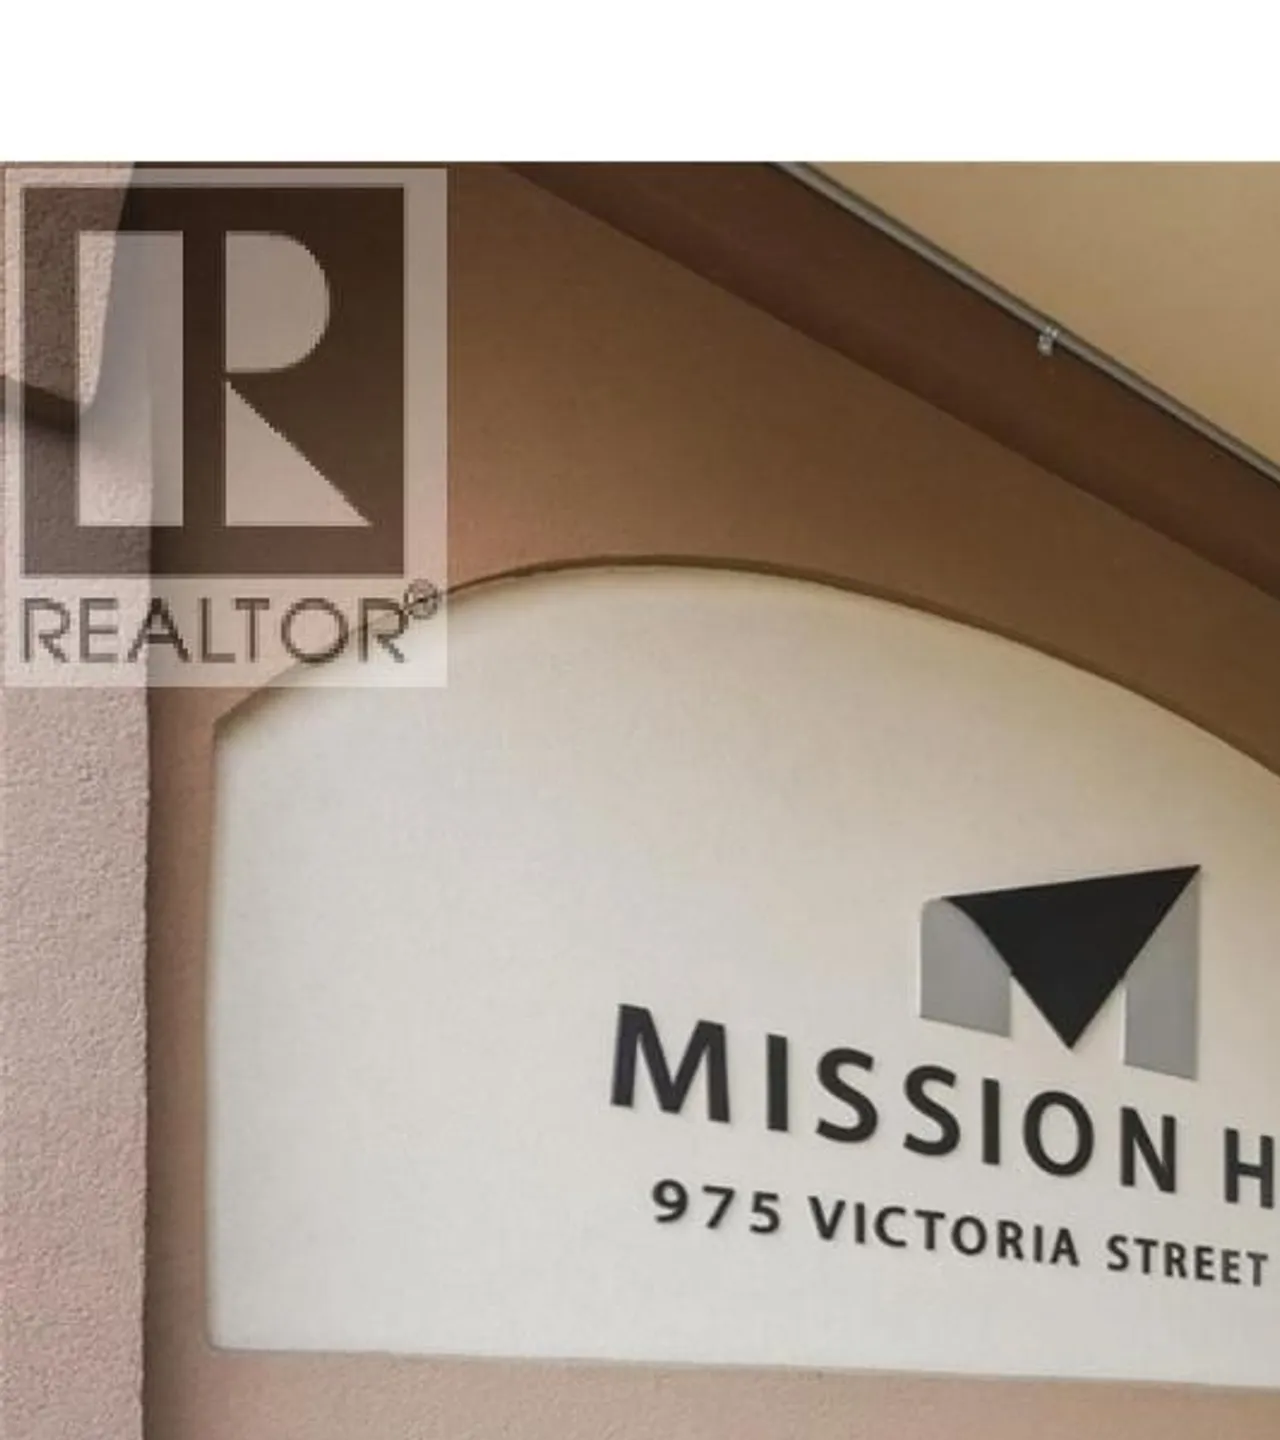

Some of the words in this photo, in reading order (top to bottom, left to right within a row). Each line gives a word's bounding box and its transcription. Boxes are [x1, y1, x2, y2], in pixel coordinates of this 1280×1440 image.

[610, 1003, 1177, 1193] MISSION
[652, 1179, 780, 1234] 975
[808, 1195, 1080, 1268] VICTORIA
[1107, 1234, 1268, 1288] STREET
